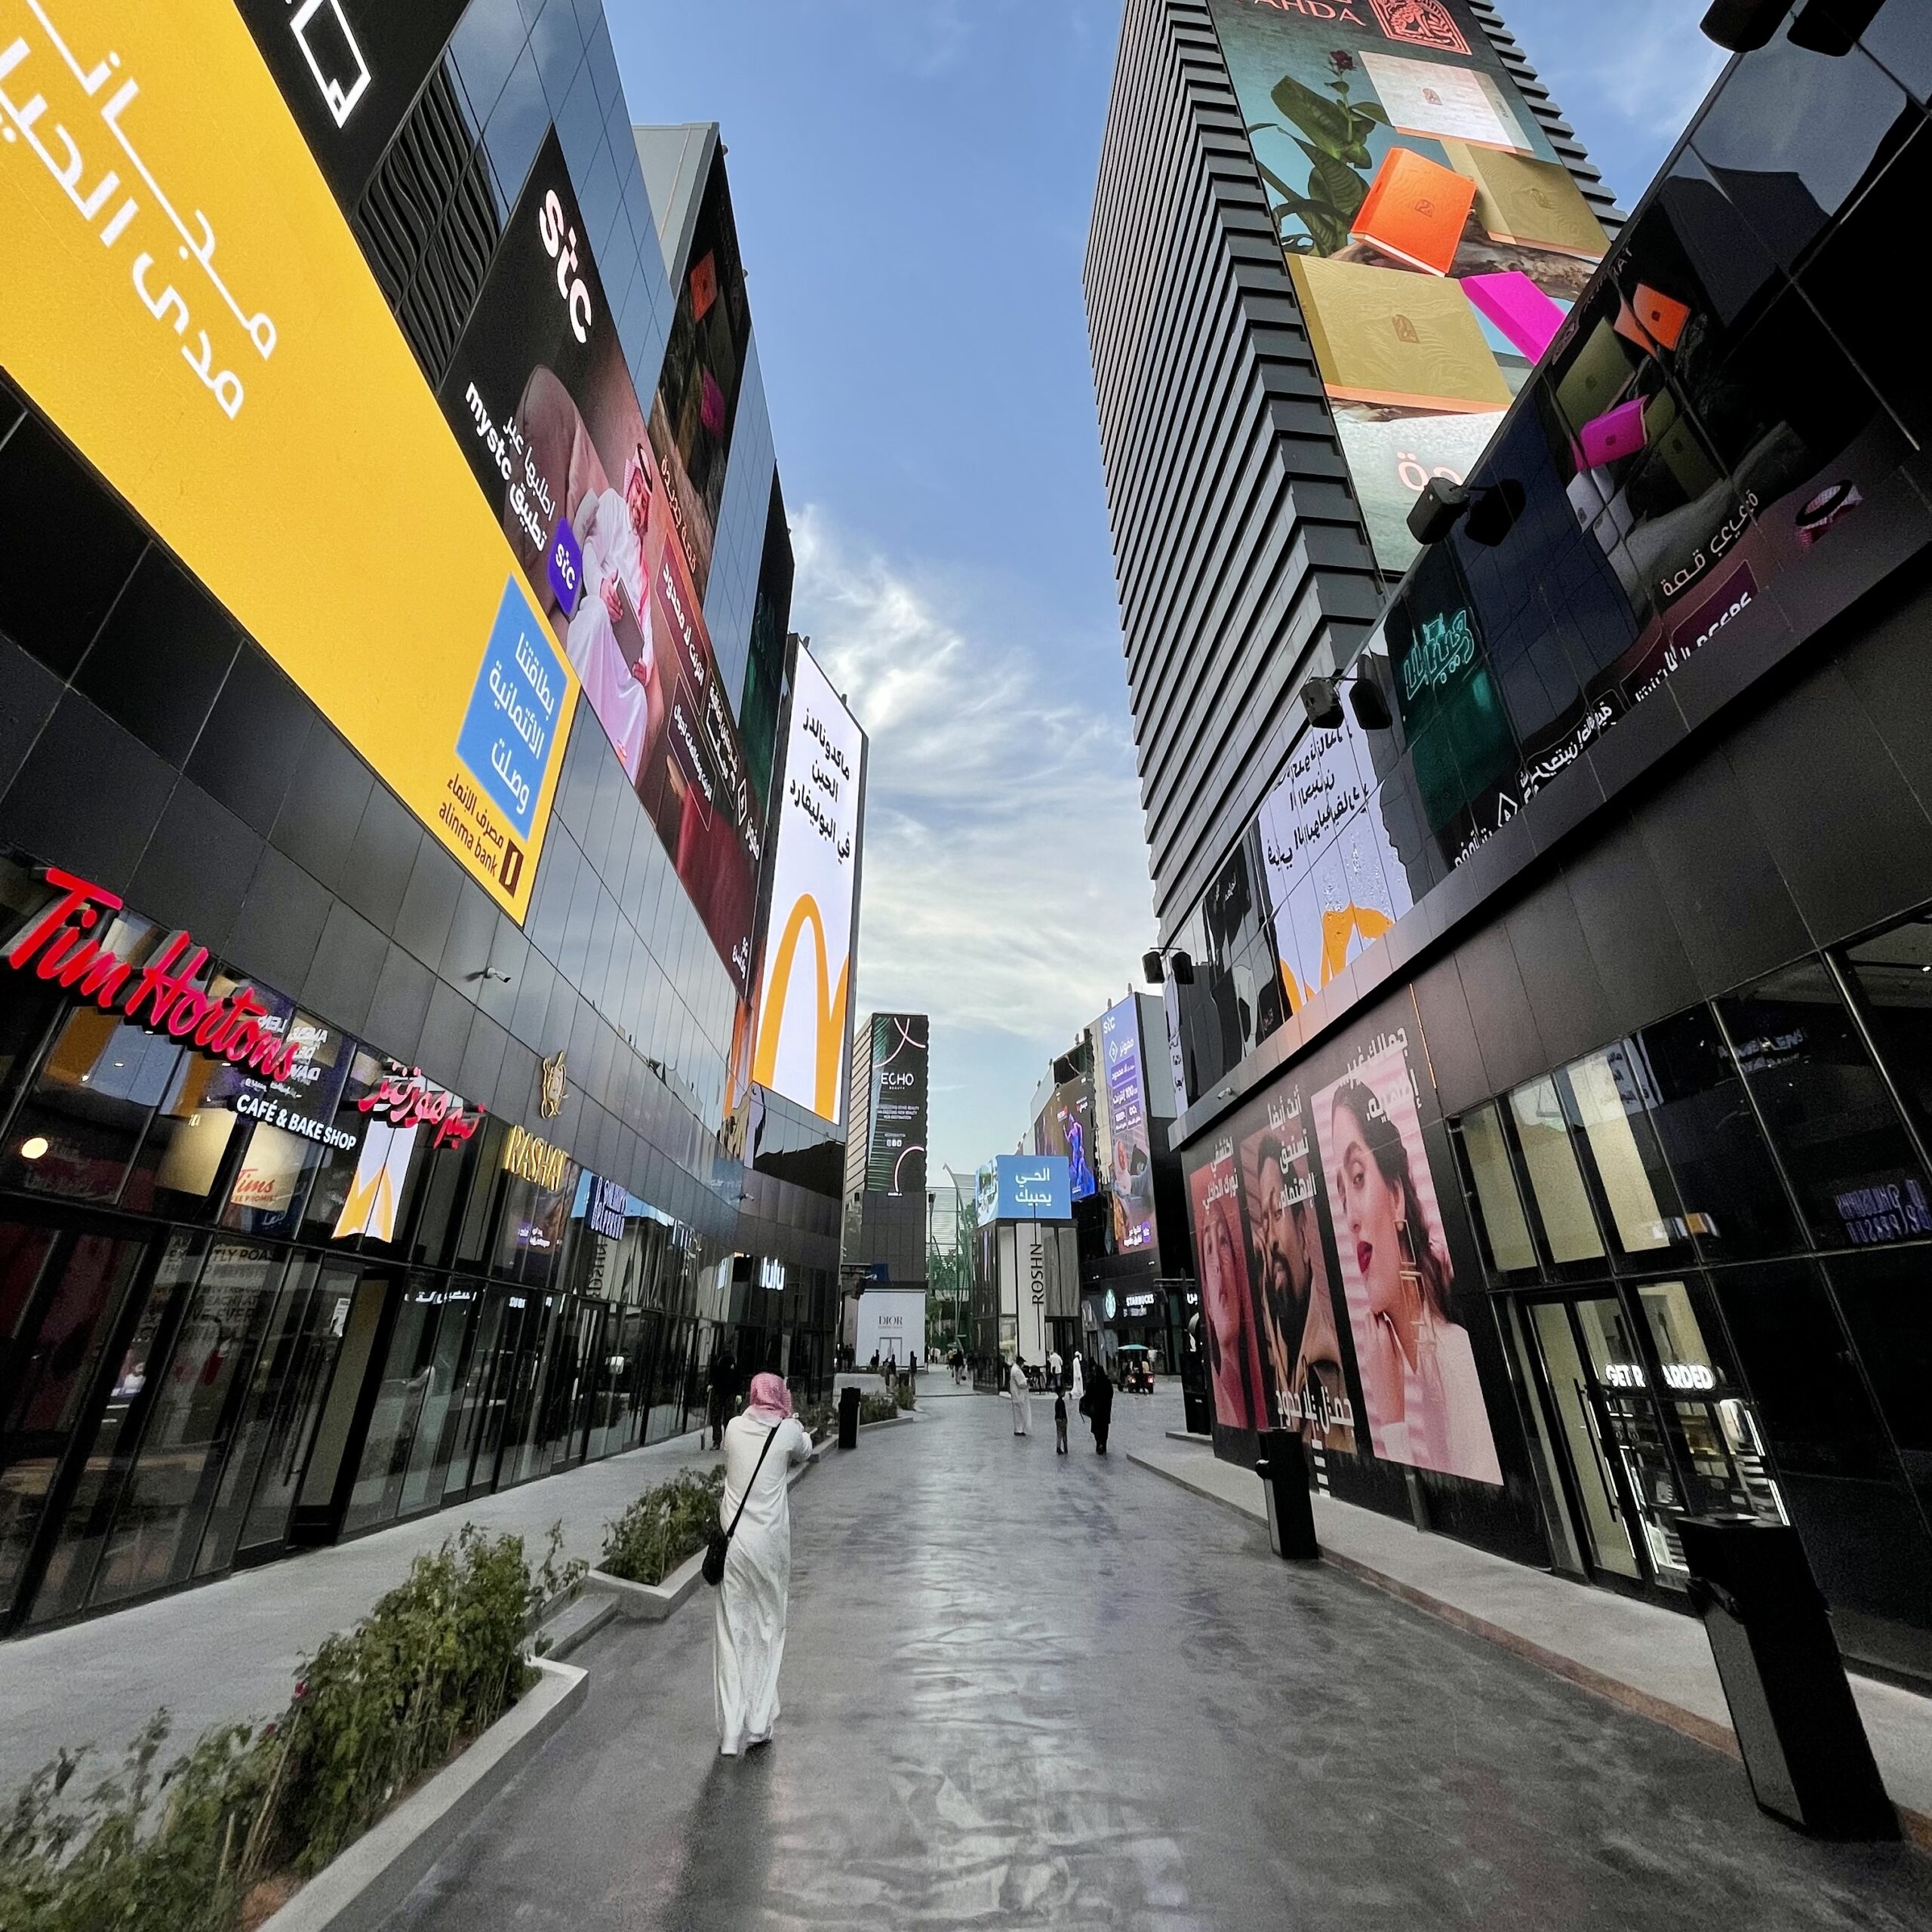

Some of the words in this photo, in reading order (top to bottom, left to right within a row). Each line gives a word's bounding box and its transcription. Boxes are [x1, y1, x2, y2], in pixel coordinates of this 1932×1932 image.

[539, 189, 592, 344] stc
[132, 251, 245, 420] مدى
[465, 381, 512, 481] mystc
[503, 416, 525, 455] عبر
[525, 445, 556, 521] اطلبها
[509, 482, 548, 552] تطبيق
[555, 543, 577, 592] stc
[662, 561, 685, 631] محدود
[515, 631, 555, 721] بطاقتنا
[802, 707, 851, 781] ماكدونالدز
[491, 738, 531, 816] وصلت
[811, 759, 838, 803] الحين
[438, 801, 475, 852] alinma
[472, 841, 500, 878] bank
[789, 779, 836, 844] البوليفارد
[837, 831, 851, 865] في
[9, 866, 131, 1008] Tim
[125, 929, 301, 1082] Hortons
[1103, 1015, 1116, 1035] stc
[880, 1072, 915, 1087] ECHO
[236, 1094, 278, 1123] CAFÉ
[275, 1108, 288, 1128] &
[288, 1112, 325, 1140] BAKE
[322, 1126, 357, 1151] SHOP
[1279, 1128, 1309, 1174] تستحق
[1014, 1167, 1051, 1188] الحي
[760, 1256, 786, 1291] lulu
[1029, 1243, 1045, 1305] ROSHN
[1125, 1294, 1155, 1307] STARBUCKS
[878, 1315, 903, 1325] DIOR
[1604, 1363, 1633, 1388] GET
